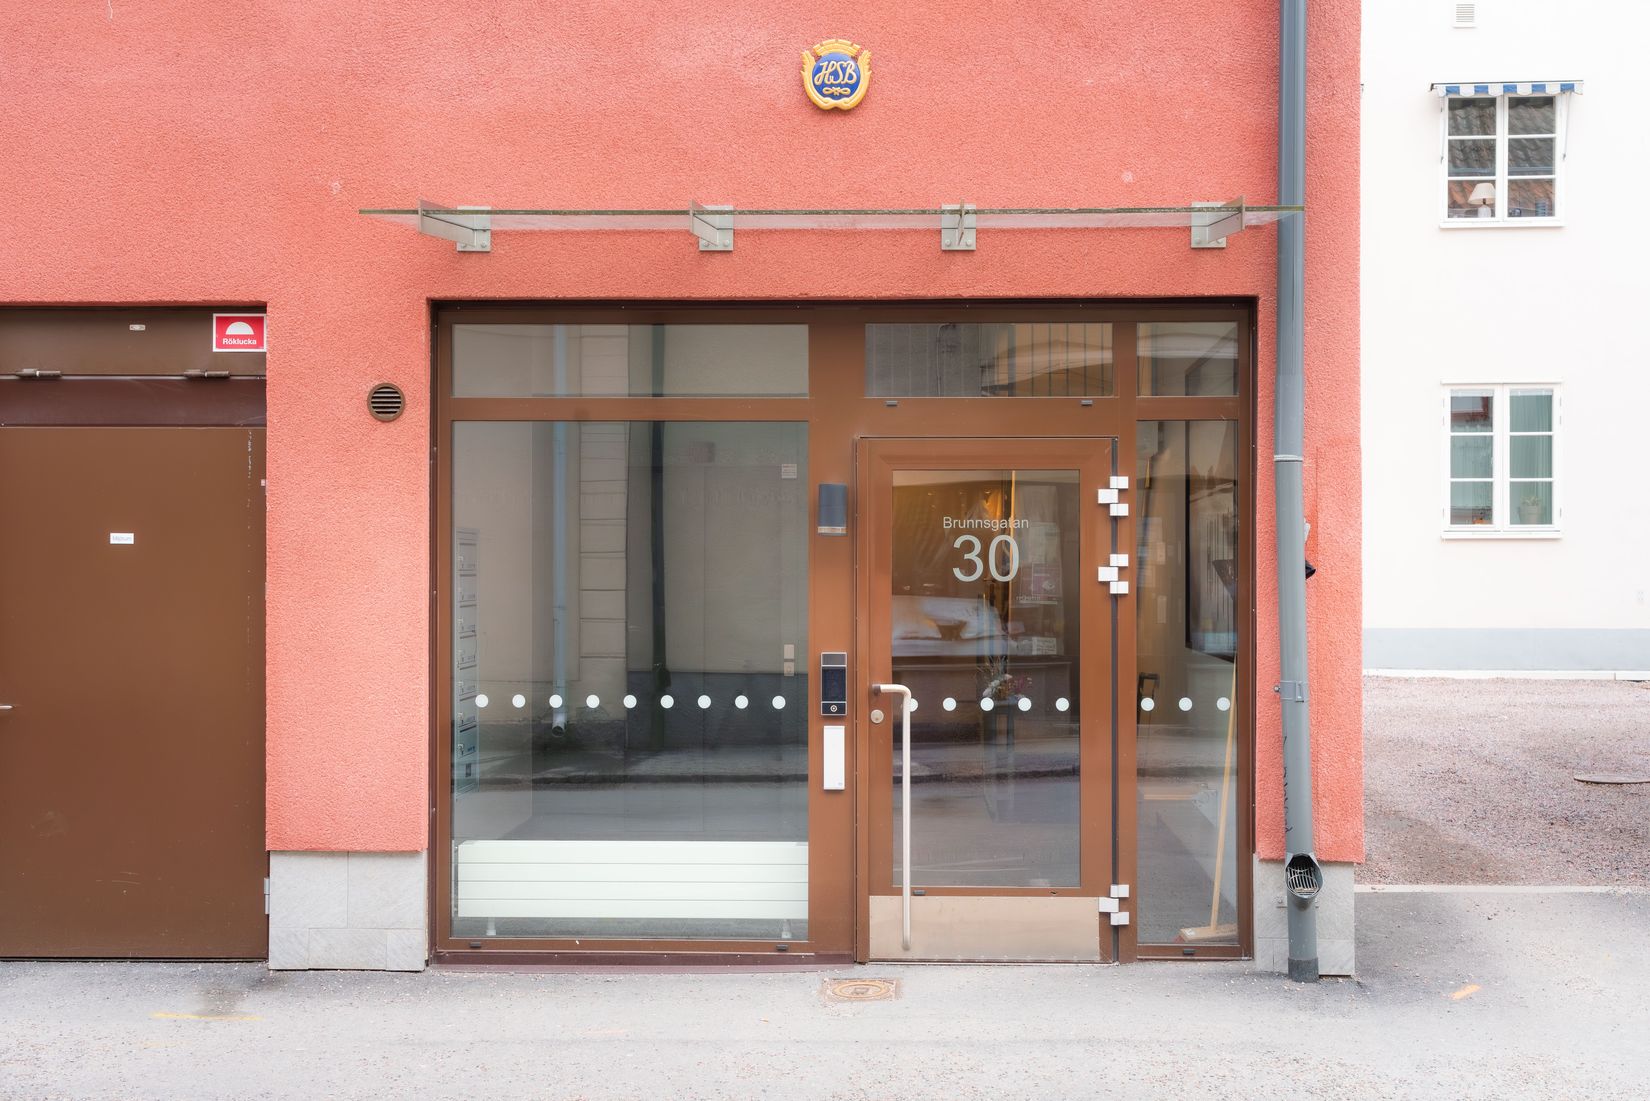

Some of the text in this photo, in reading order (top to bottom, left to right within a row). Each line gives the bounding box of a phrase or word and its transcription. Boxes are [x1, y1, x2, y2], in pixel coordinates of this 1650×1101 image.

[813, 60, 858, 86] HSB
[222, 337, 257, 345] Röklucka
[943, 516, 1029, 531] Brunnsgatan
[952, 534, 1020, 582] 30
